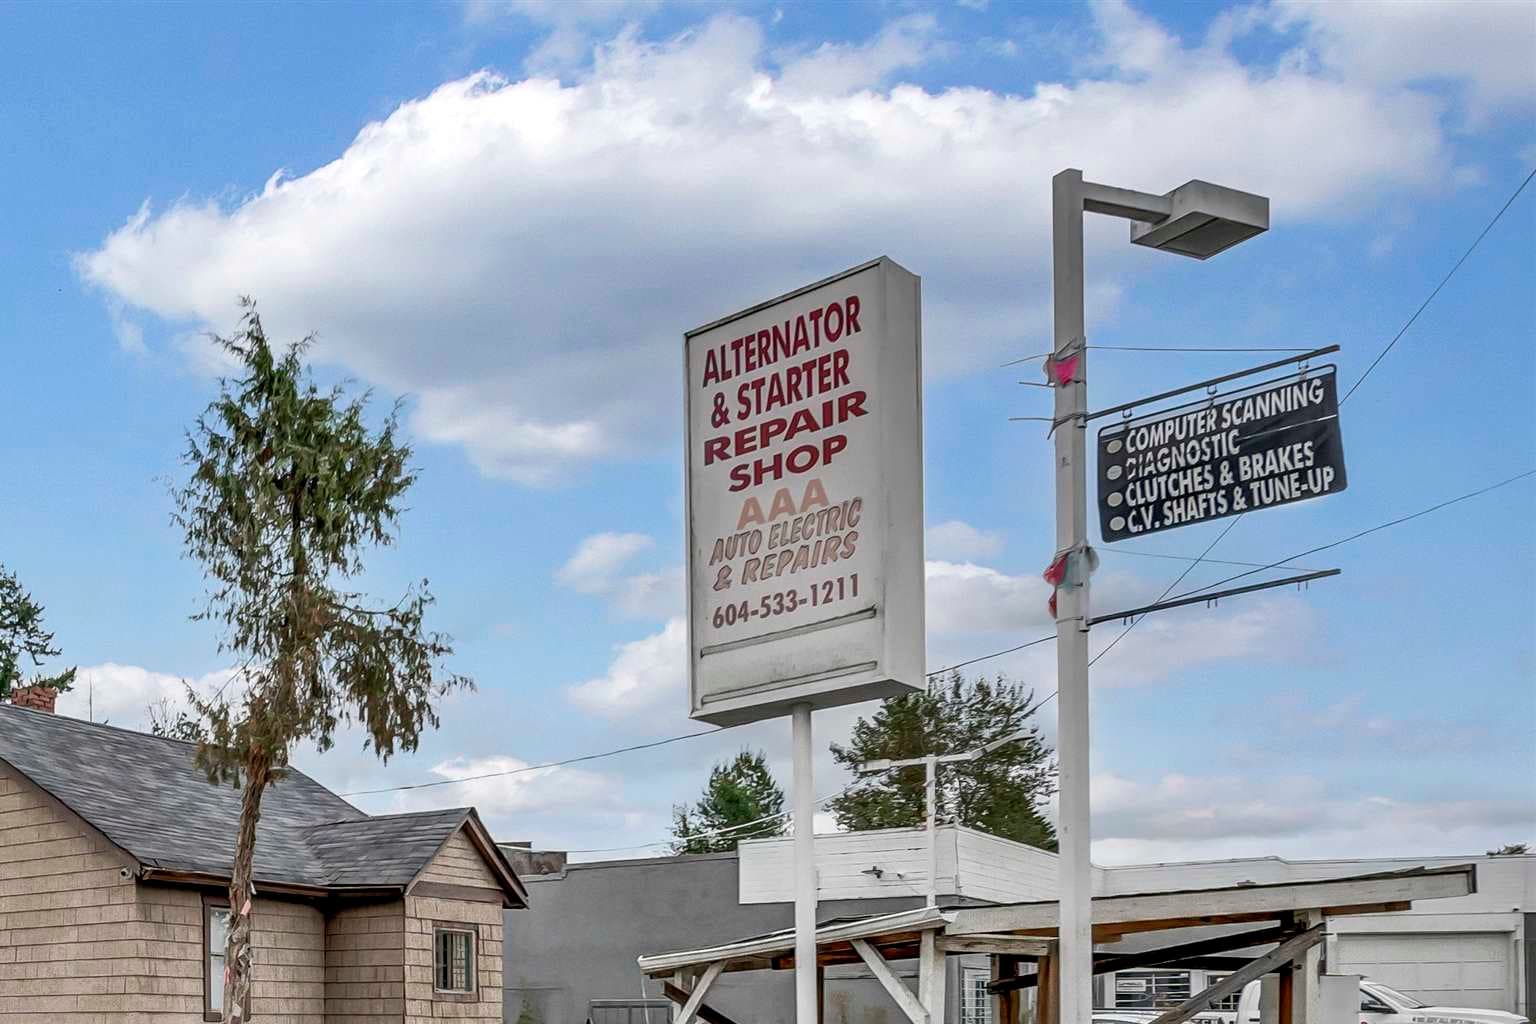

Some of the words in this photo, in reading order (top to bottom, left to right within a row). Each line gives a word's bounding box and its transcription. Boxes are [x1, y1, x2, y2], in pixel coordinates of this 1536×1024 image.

[702, 295, 863, 388] ALTERNATOR
[711, 391, 731, 429] &
[737, 348, 850, 421] STARTER
[1125, 407, 1218, 454] COMPUTER
[1221, 378, 1325, 427] SCANNING
[704, 390, 870, 466] REPAIR
[1126, 429, 1241, 480] DIAGNOSTIC
[728, 433, 848, 492] SHOP
[1125, 464, 1214, 508] CLUTCHES
[1219, 463, 1235, 485] &
[1239, 440, 1315, 482] BRAKES
[709, 528, 762, 567] AUTO
[767, 497, 863, 550] ELECTRIC
[736, 478, 830, 531] AAA
[1127, 505, 1160, 534] C.V.
[1164, 490, 1228, 527] SHAFTS
[1233, 489, 1248, 511] &
[1250, 465, 1336, 508] TUNE-UP
[712, 564, 732, 592] &
[741, 531, 859, 585] REPAIRS
[713, 573, 859, 629] 604-533-1211
